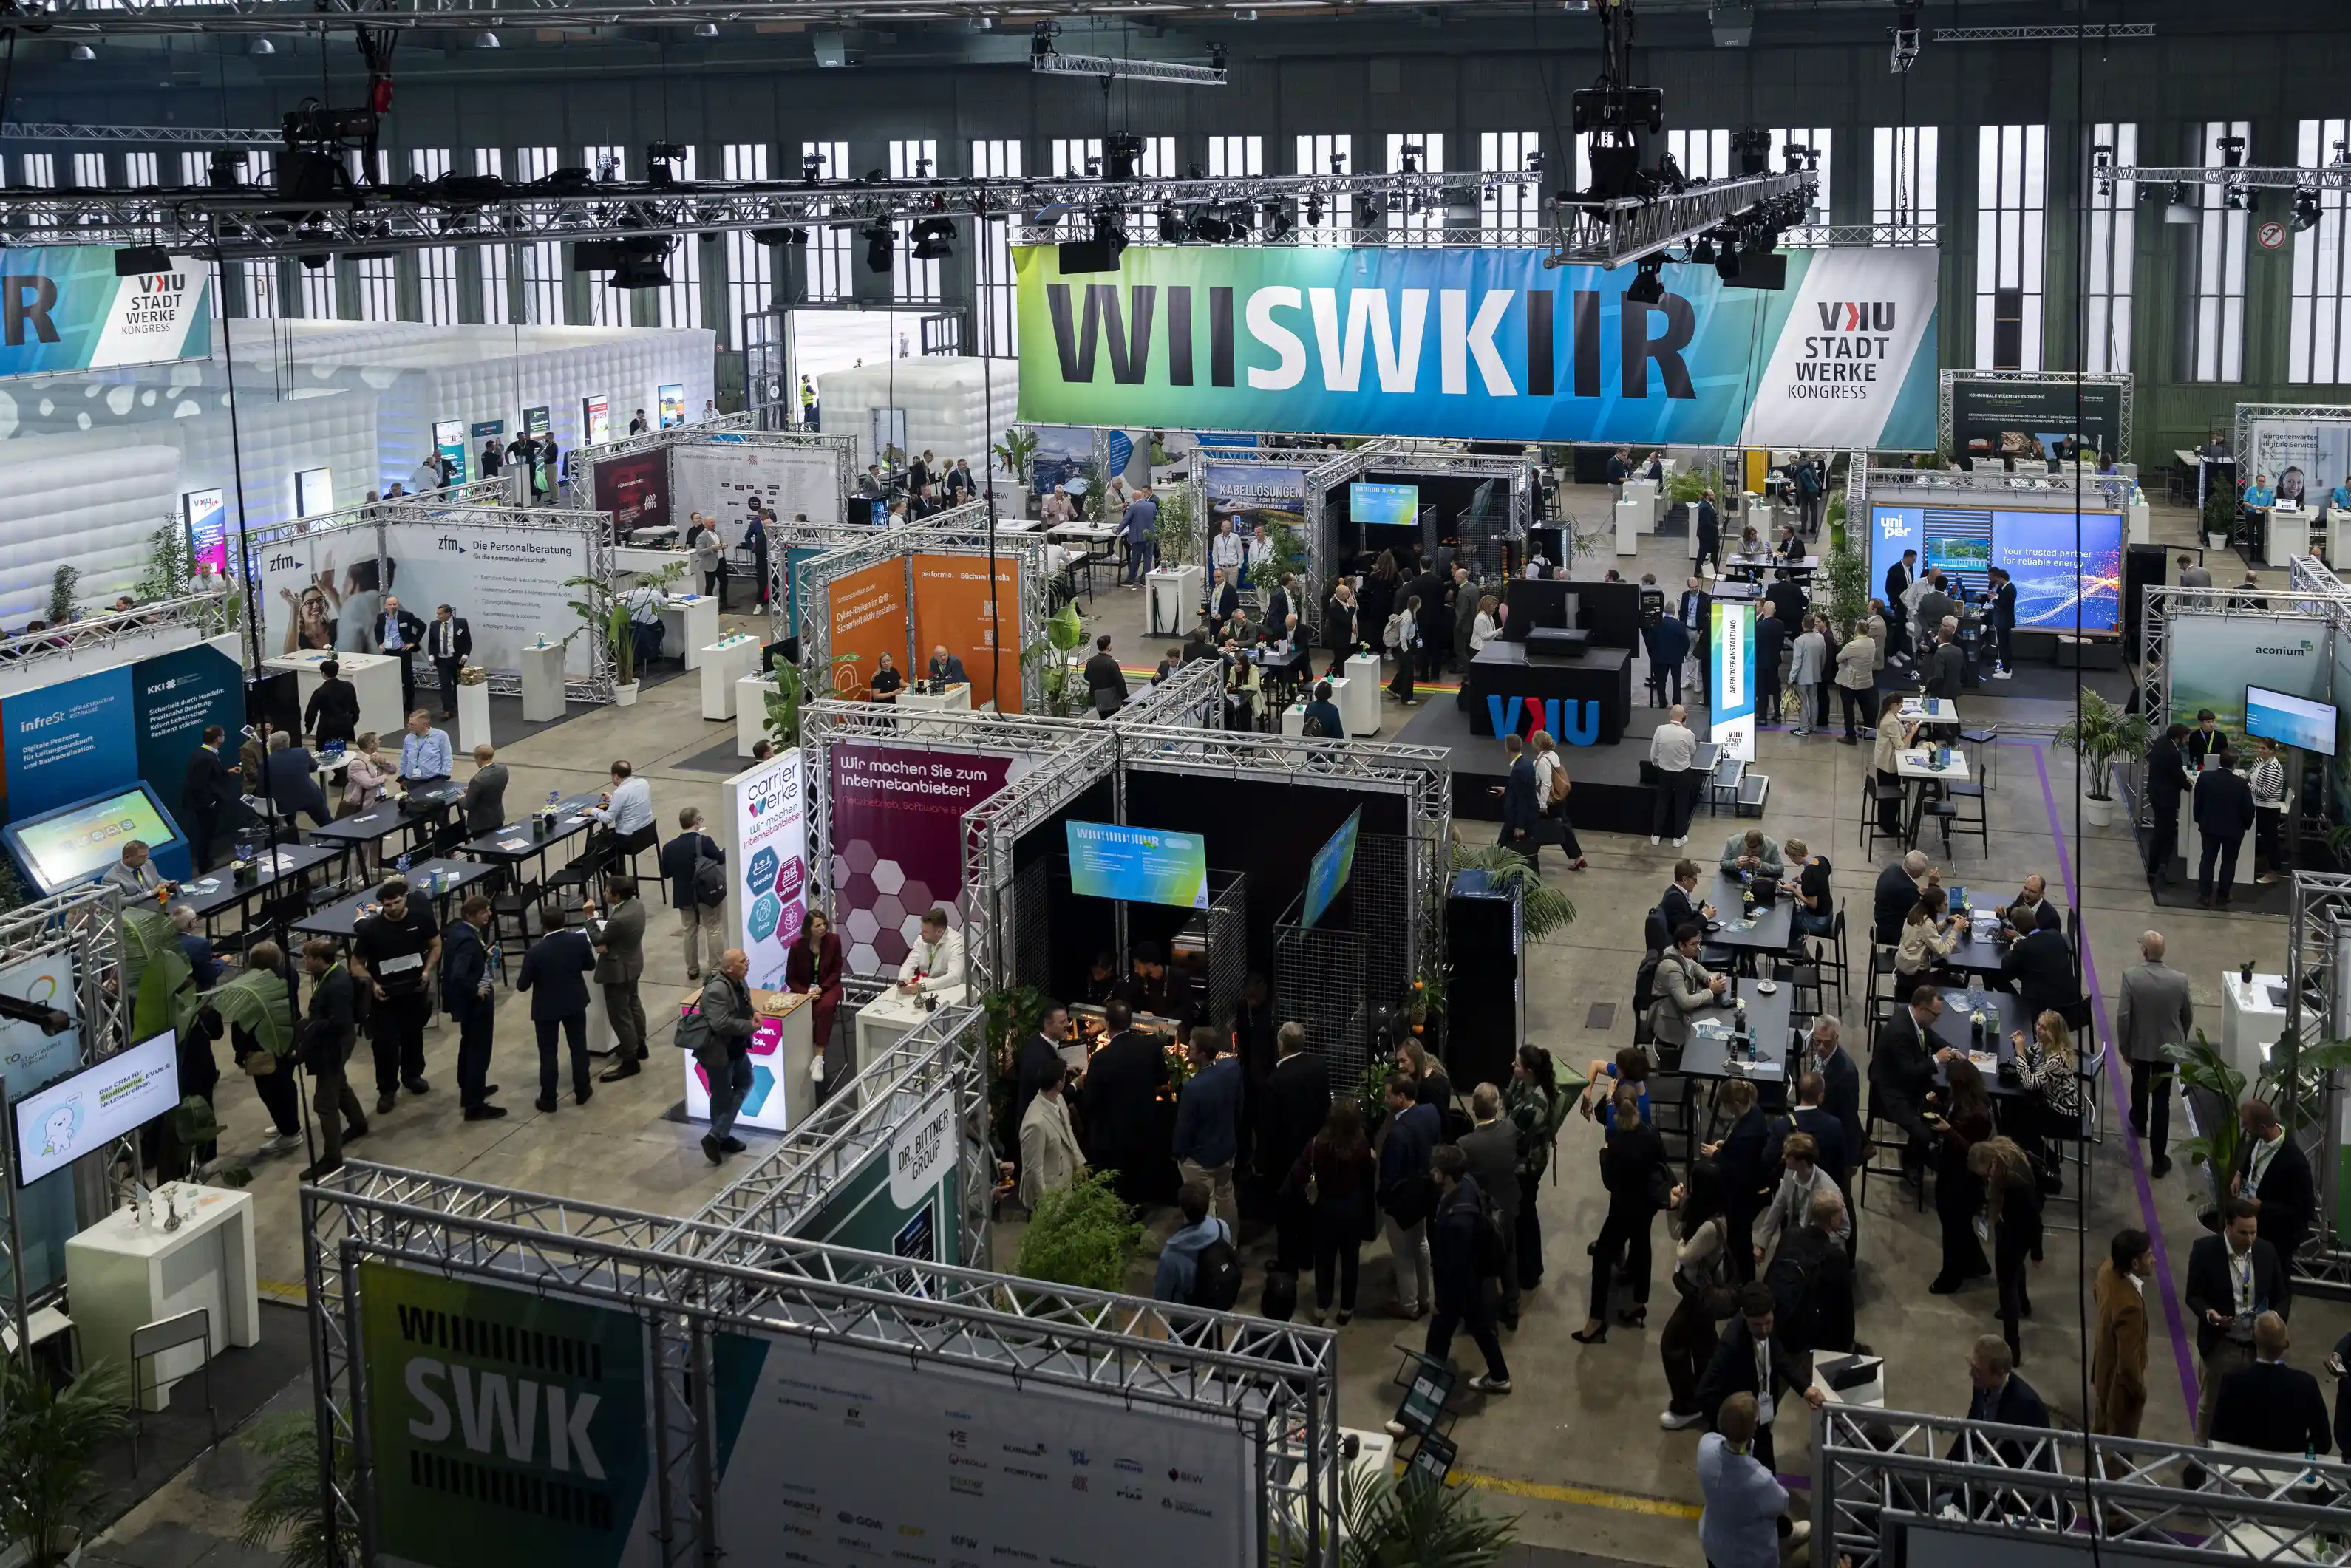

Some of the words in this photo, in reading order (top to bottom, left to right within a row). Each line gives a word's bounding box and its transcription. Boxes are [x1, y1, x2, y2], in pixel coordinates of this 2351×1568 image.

[138, 274, 185, 293] VKU
[132, 294, 183, 310] STADT
[126, 309, 175, 324] WERKE
[1817, 302, 1896, 331] VKU
[121, 323, 171, 335] KONGRESS
[1805, 336, 1889, 359] STADT
[1796, 362, 1877, 381] WERKE
[1788, 384, 1867, 399] KONGRESS
[1219, 482, 1303, 498] KABELLÖSUNGEN
[1880, 515, 1903, 528] uni
[1885, 526, 1911, 539] per
[438, 535, 457, 550] zfm
[473, 540, 487, 550] Die
[490, 542, 572, 557] Personalberatung
[2004, 547, 2024, 556] Your
[2025, 549, 2057, 557] trusted
[2060, 549, 2093, 559] partner
[269, 553, 293, 572] zfm
[491, 555, 547, 564] Kommunalwirtschaft
[2003, 556, 2016, 565] for
[2018, 557, 2051, 567] reliable
[2053, 559, 2083, 569] energy
[837, 601, 871, 622] Cyber-Risiken
[871, 599, 878, 607] im
[878, 592, 890, 604] Griff
[837, 616, 863, 633] Sicherheit
[863, 612, 875, 622] aktiv
[2256, 645, 2304, 656] aconium
[148, 683, 165, 695] KKI
[149, 701, 180, 715] Sicherheit
[180, 696, 197, 706] durch
[199, 688, 225, 701] Handeln:
[150, 709, 183, 723] Praxisnahe
[184, 700, 213, 712] Beratung.
[21, 711, 65, 732] infreSt
[69, 696, 115, 713] INFRASTRUKTUR
[150, 720, 169, 731] Krisen
[171, 709, 208, 724] beherrschen.
[151, 726, 177, 738] Resilienz
[179, 718, 203, 729] stärken.
[23, 741, 49, 753] Digitale
[50, 733, 80, 746] Prozesse
[23, 754, 34, 762] für
[35, 736, 94, 758] Leitungsauskunft
[24, 761, 38, 770] und
[38, 745, 96, 765] Baukoordination.
[840, 756, 865, 769] Wir
[869, 760, 927, 776] machen
[930, 764, 953, 777] Sie
[956, 769, 987, 781] zum
[748, 763, 797, 800] carrier
[841, 773, 970, 797] Internetanbieter!
[842, 795, 902, 810] Netzbetrieb,
[903, 802, 949, 814] Software
[743, 810, 803, 849] Internetanbieter
[749, 821, 764, 835] Wir
[766, 803, 798, 826] machen
[753, 873, 772, 887] Dienste
[778, 880, 802, 898] Software
[758, 921, 770, 932] Netz
[99, 1085, 112, 1095] Das
[114, 1075, 131, 1088] CRM
[132, 1070, 143, 1079] für
[101, 1077, 145, 1102] Stadtwerke,
[146, 1066, 164, 1079] EVUs
[100, 1080, 151, 1108] Netzbetreiber.
[899, 1145, 913, 1171] DR.
[915, 1108, 949, 1154] BITTNER
[912, 1140, 940, 1180] GROUP
[405, 1357, 607, 1481] SWK
